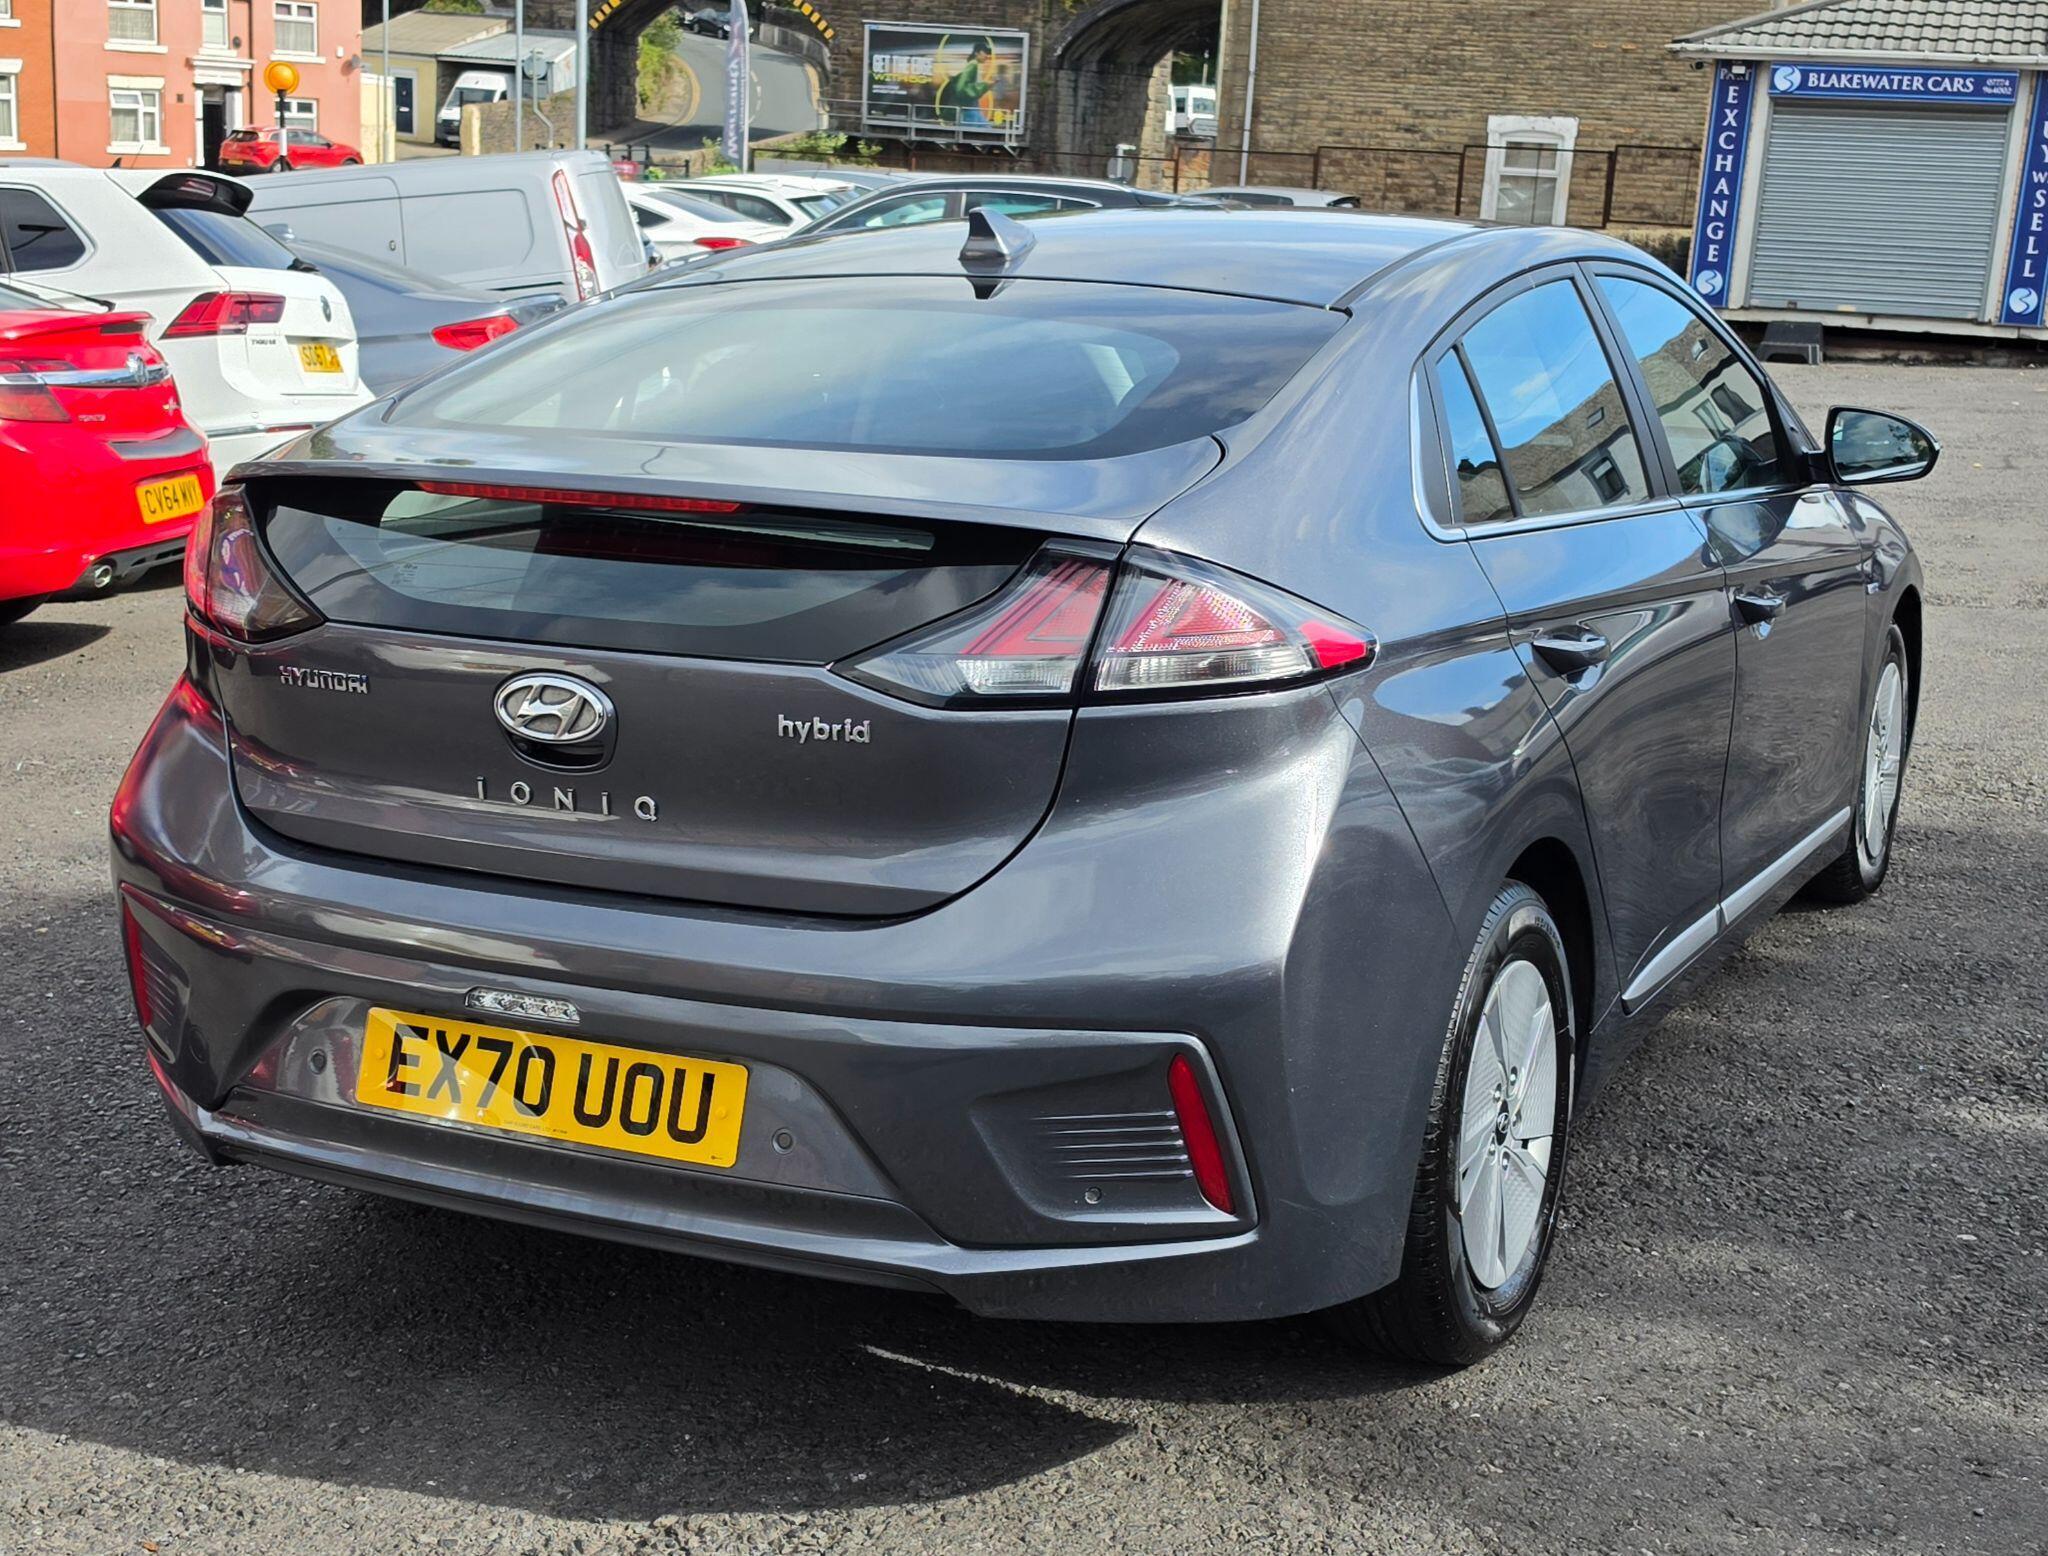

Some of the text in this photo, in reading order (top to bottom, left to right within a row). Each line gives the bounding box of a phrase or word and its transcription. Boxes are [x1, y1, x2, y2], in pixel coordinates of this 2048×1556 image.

[1808, 72, 1975, 93] BLAKEWATER CARS
[1706, 86, 1739, 262] EXCHANGE
[2022, 189, 2047, 278] SELL
[144, 484, 181, 514] CV64
[279, 665, 368, 694] HYUNDAI
[778, 714, 870, 744] hybrid
[476, 776, 657, 822] IONIQ
[386, 1022, 716, 1145] EX70 UOU
